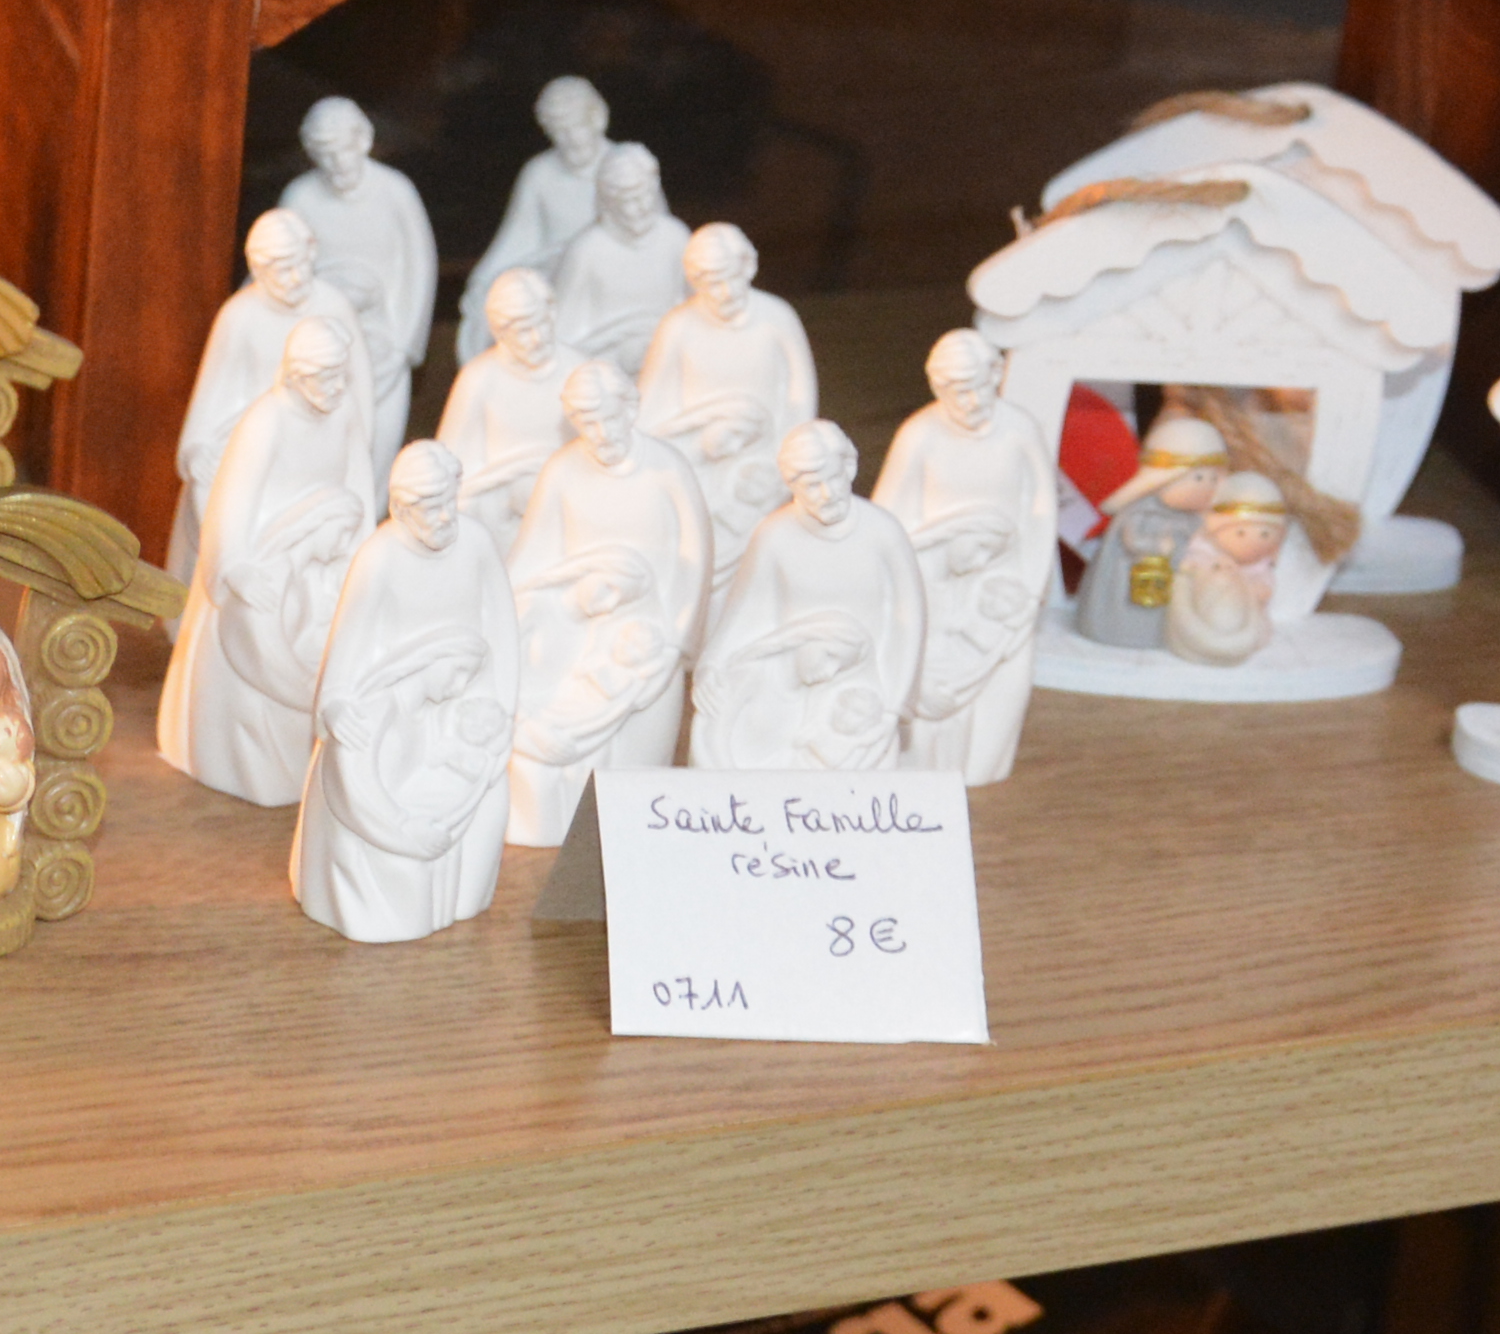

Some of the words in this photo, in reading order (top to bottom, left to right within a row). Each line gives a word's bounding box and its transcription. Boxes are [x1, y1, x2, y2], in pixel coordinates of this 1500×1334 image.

[647, 795, 765, 834] Sainte
[783, 792, 943, 835] Famille
[730, 842, 857, 883] résine
[652, 976, 749, 1011] 0711
